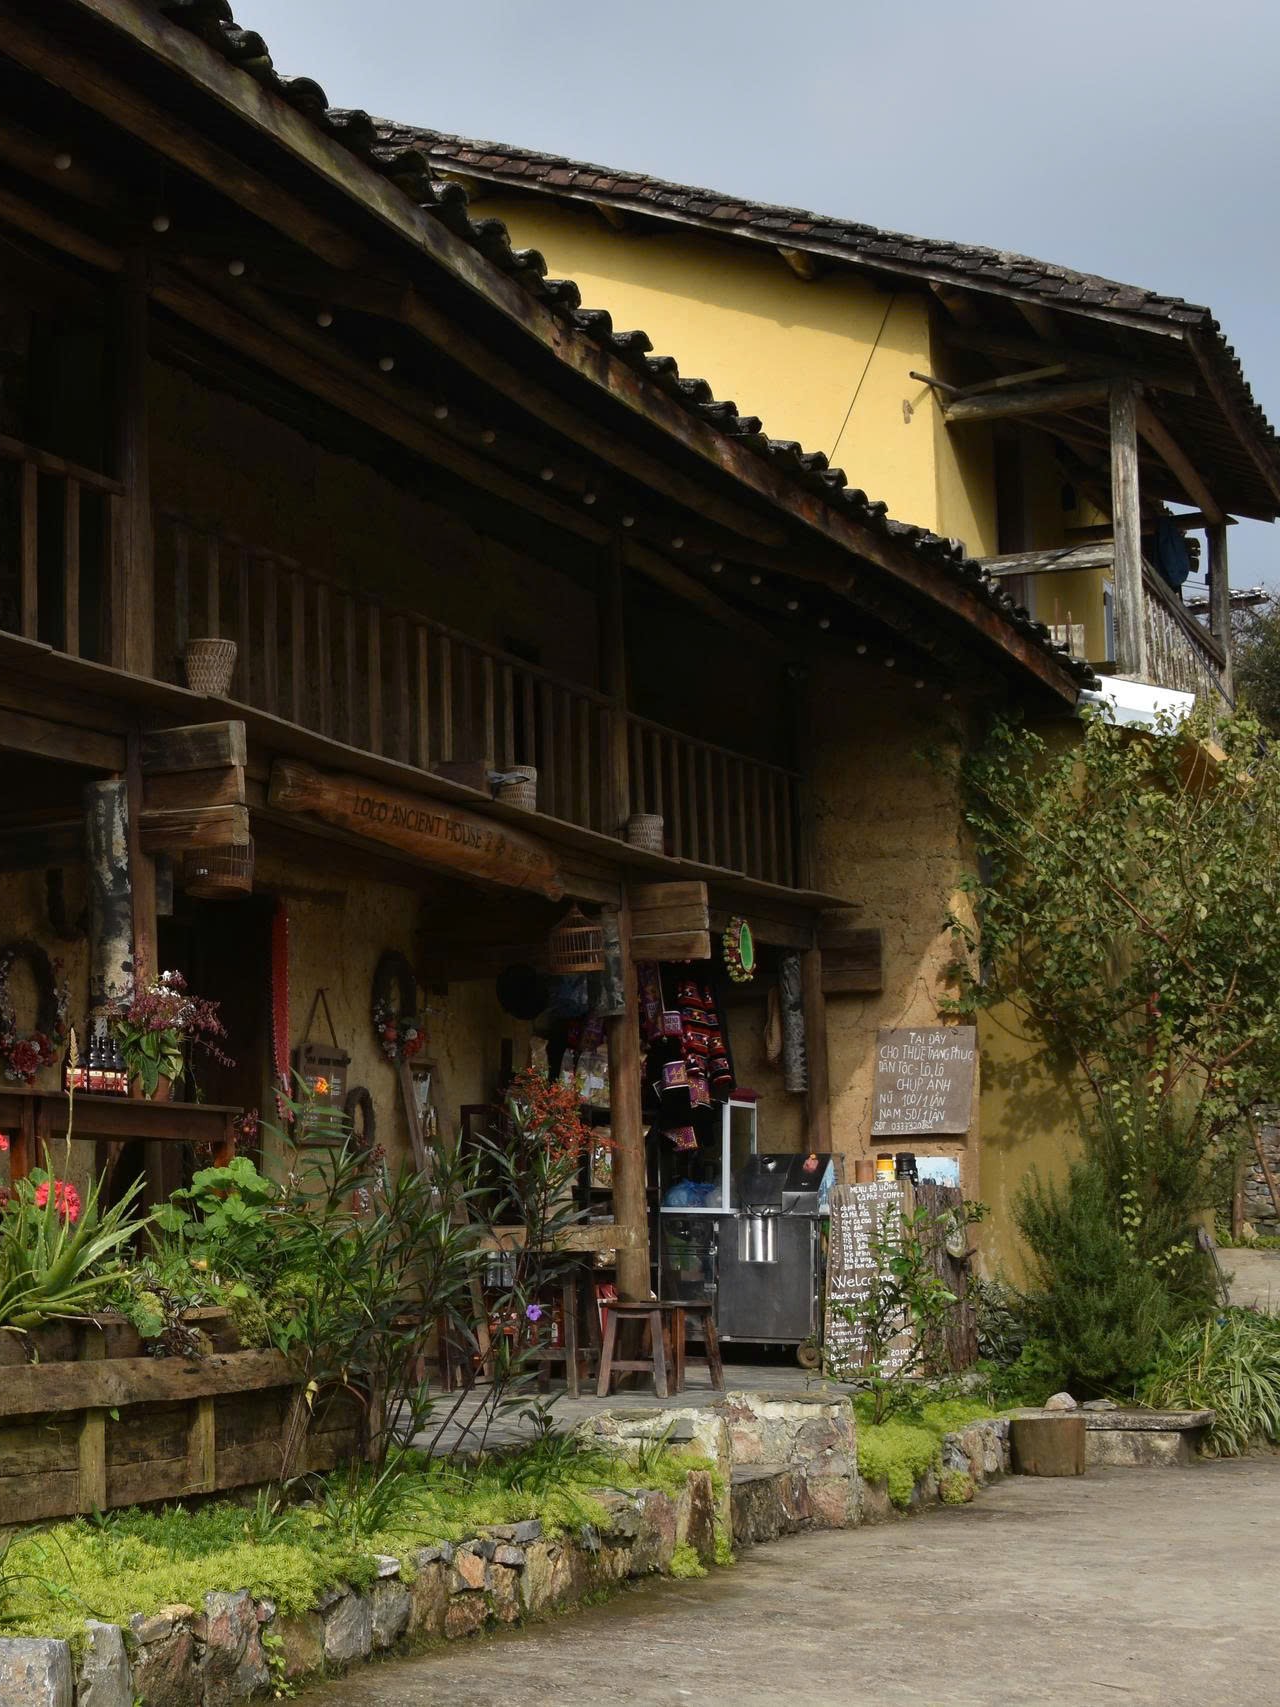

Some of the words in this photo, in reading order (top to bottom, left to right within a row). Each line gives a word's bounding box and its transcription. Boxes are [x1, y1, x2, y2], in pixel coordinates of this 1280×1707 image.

[391, 805, 442, 837] ANCIENT
[444, 820, 482, 849] HOUSE
[928, 1031, 947, 1045] ĐÂY
[880, 1045, 899, 1060] CHO
[880, 1108, 901, 1120] NAM
[850, 1184, 867, 1194] MENU
[831, 1329, 853, 1337] Lemon
